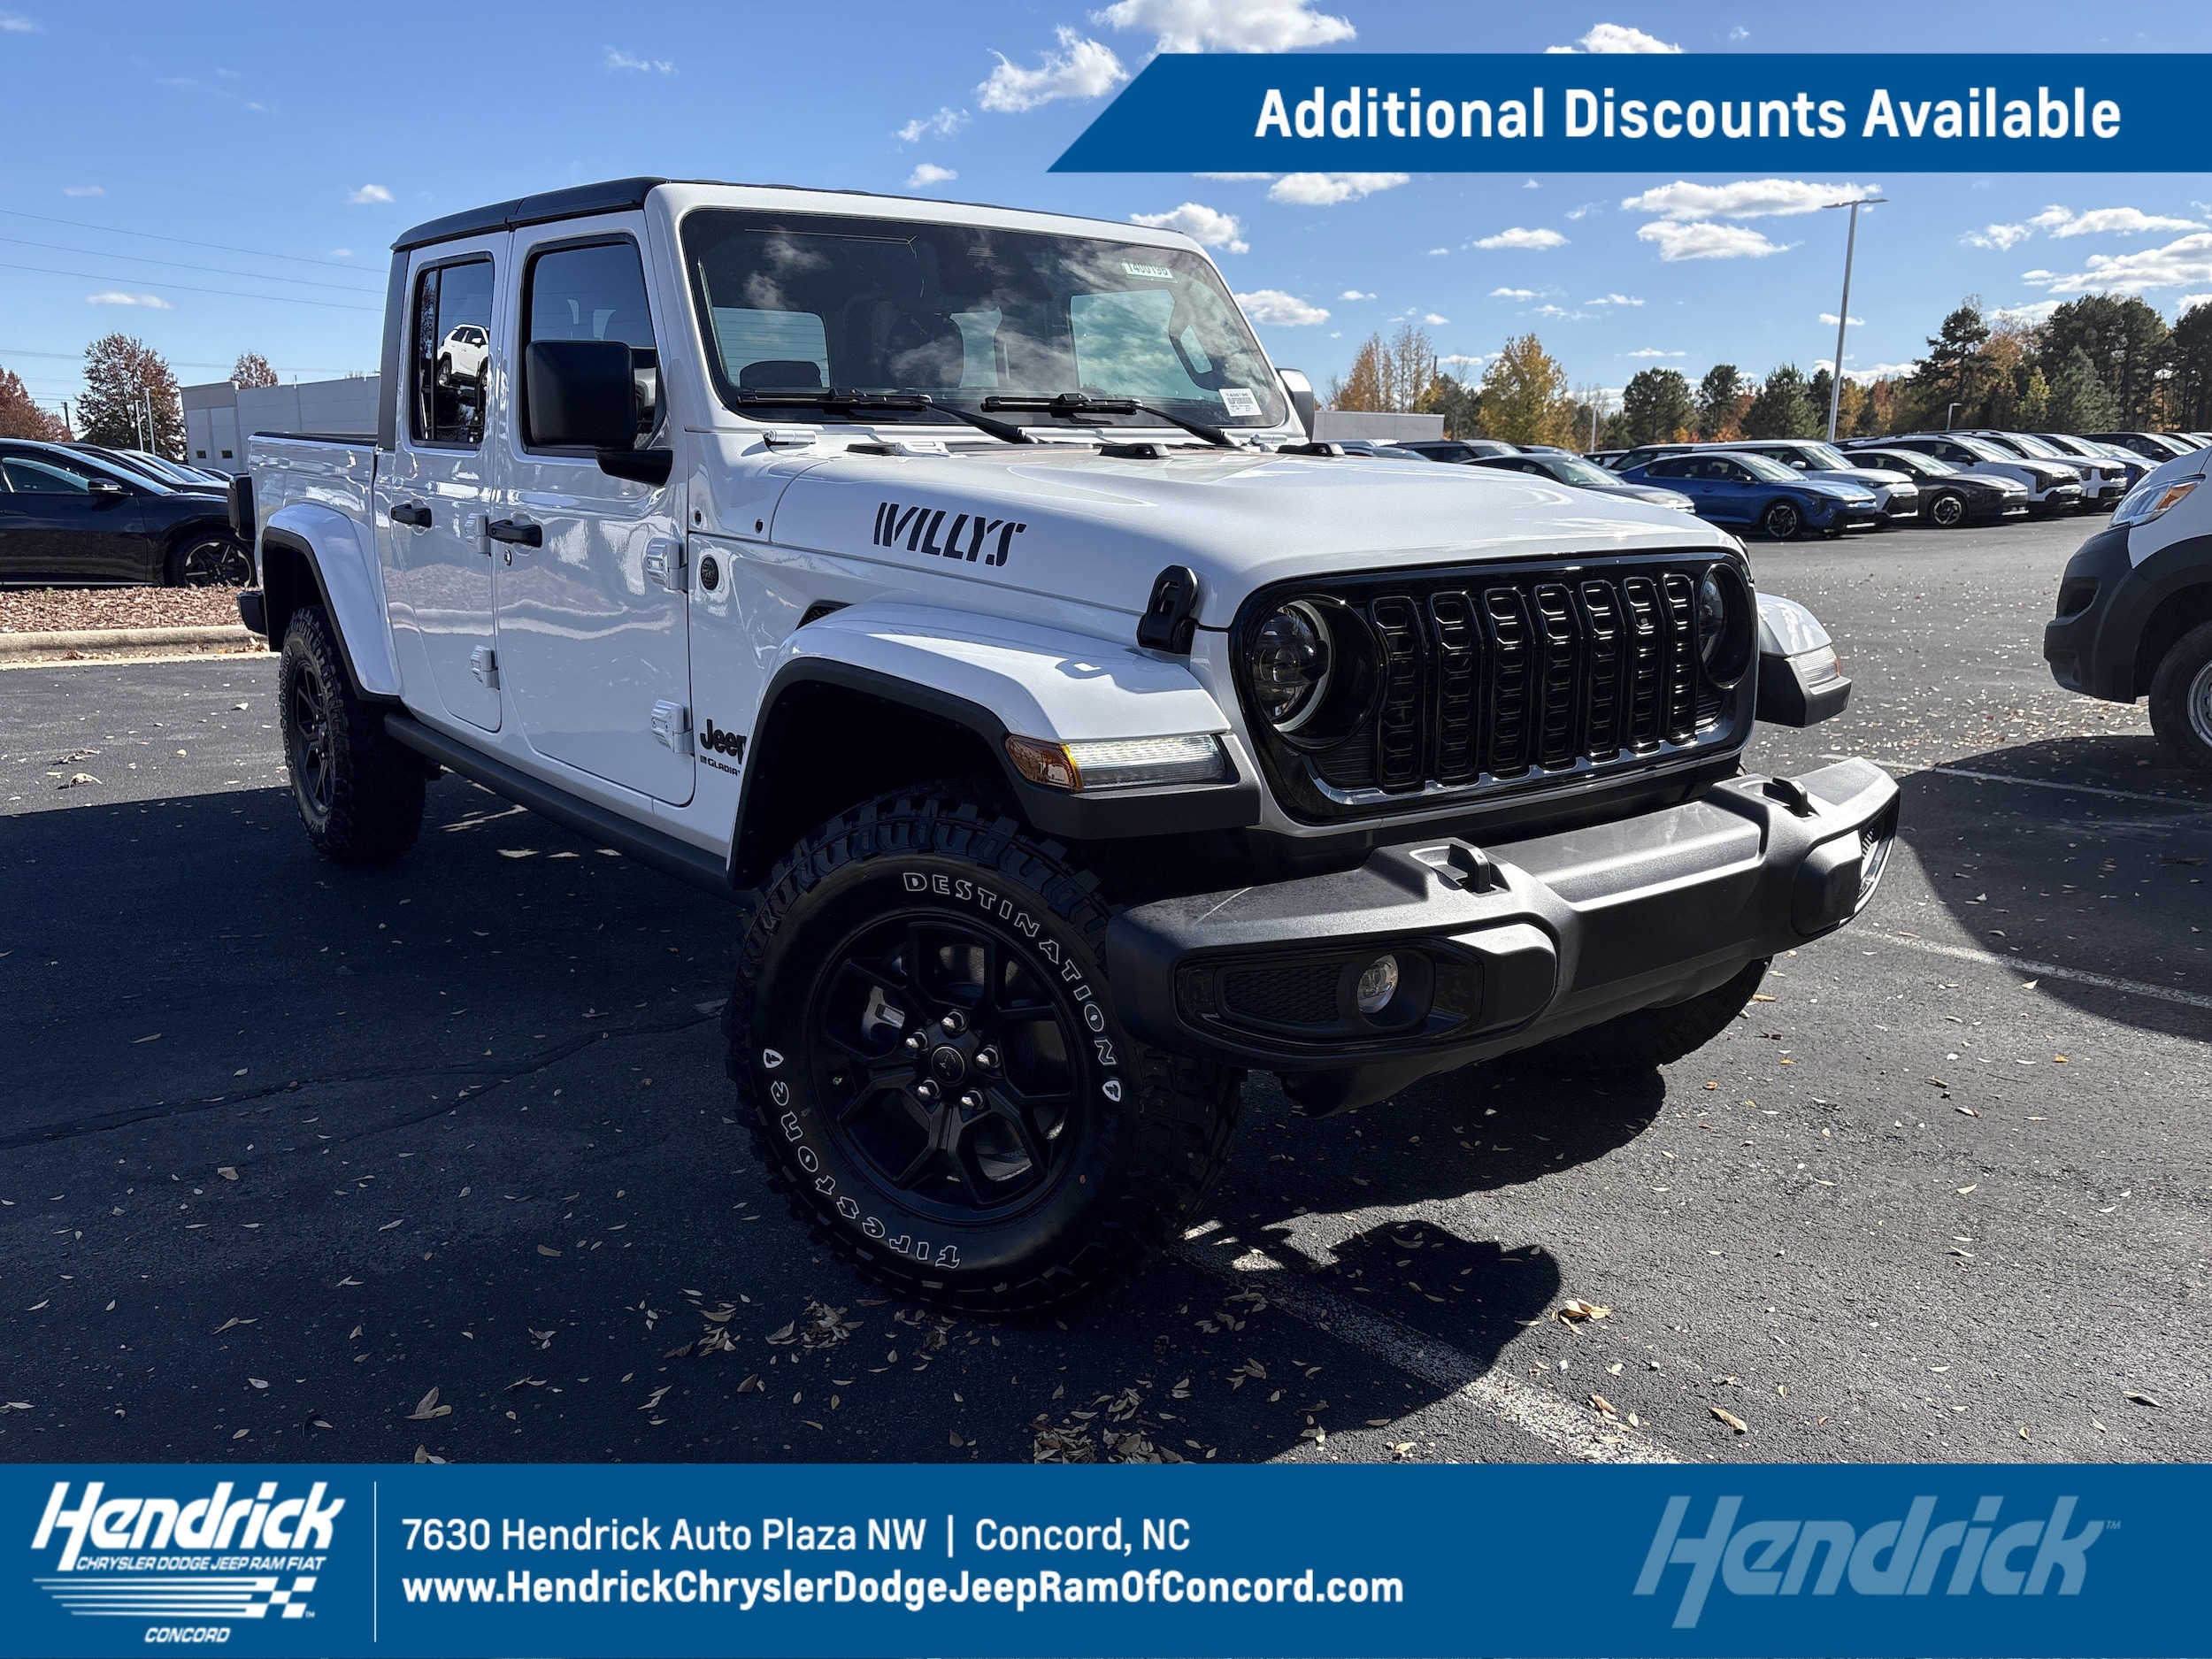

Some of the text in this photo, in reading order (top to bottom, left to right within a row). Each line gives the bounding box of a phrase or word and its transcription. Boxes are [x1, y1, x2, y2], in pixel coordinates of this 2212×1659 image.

[873, 502, 1027, 566] WILLYS
[902, 871, 1118, 1067] DESTINATION
[770, 1079, 961, 1270] Firestone
